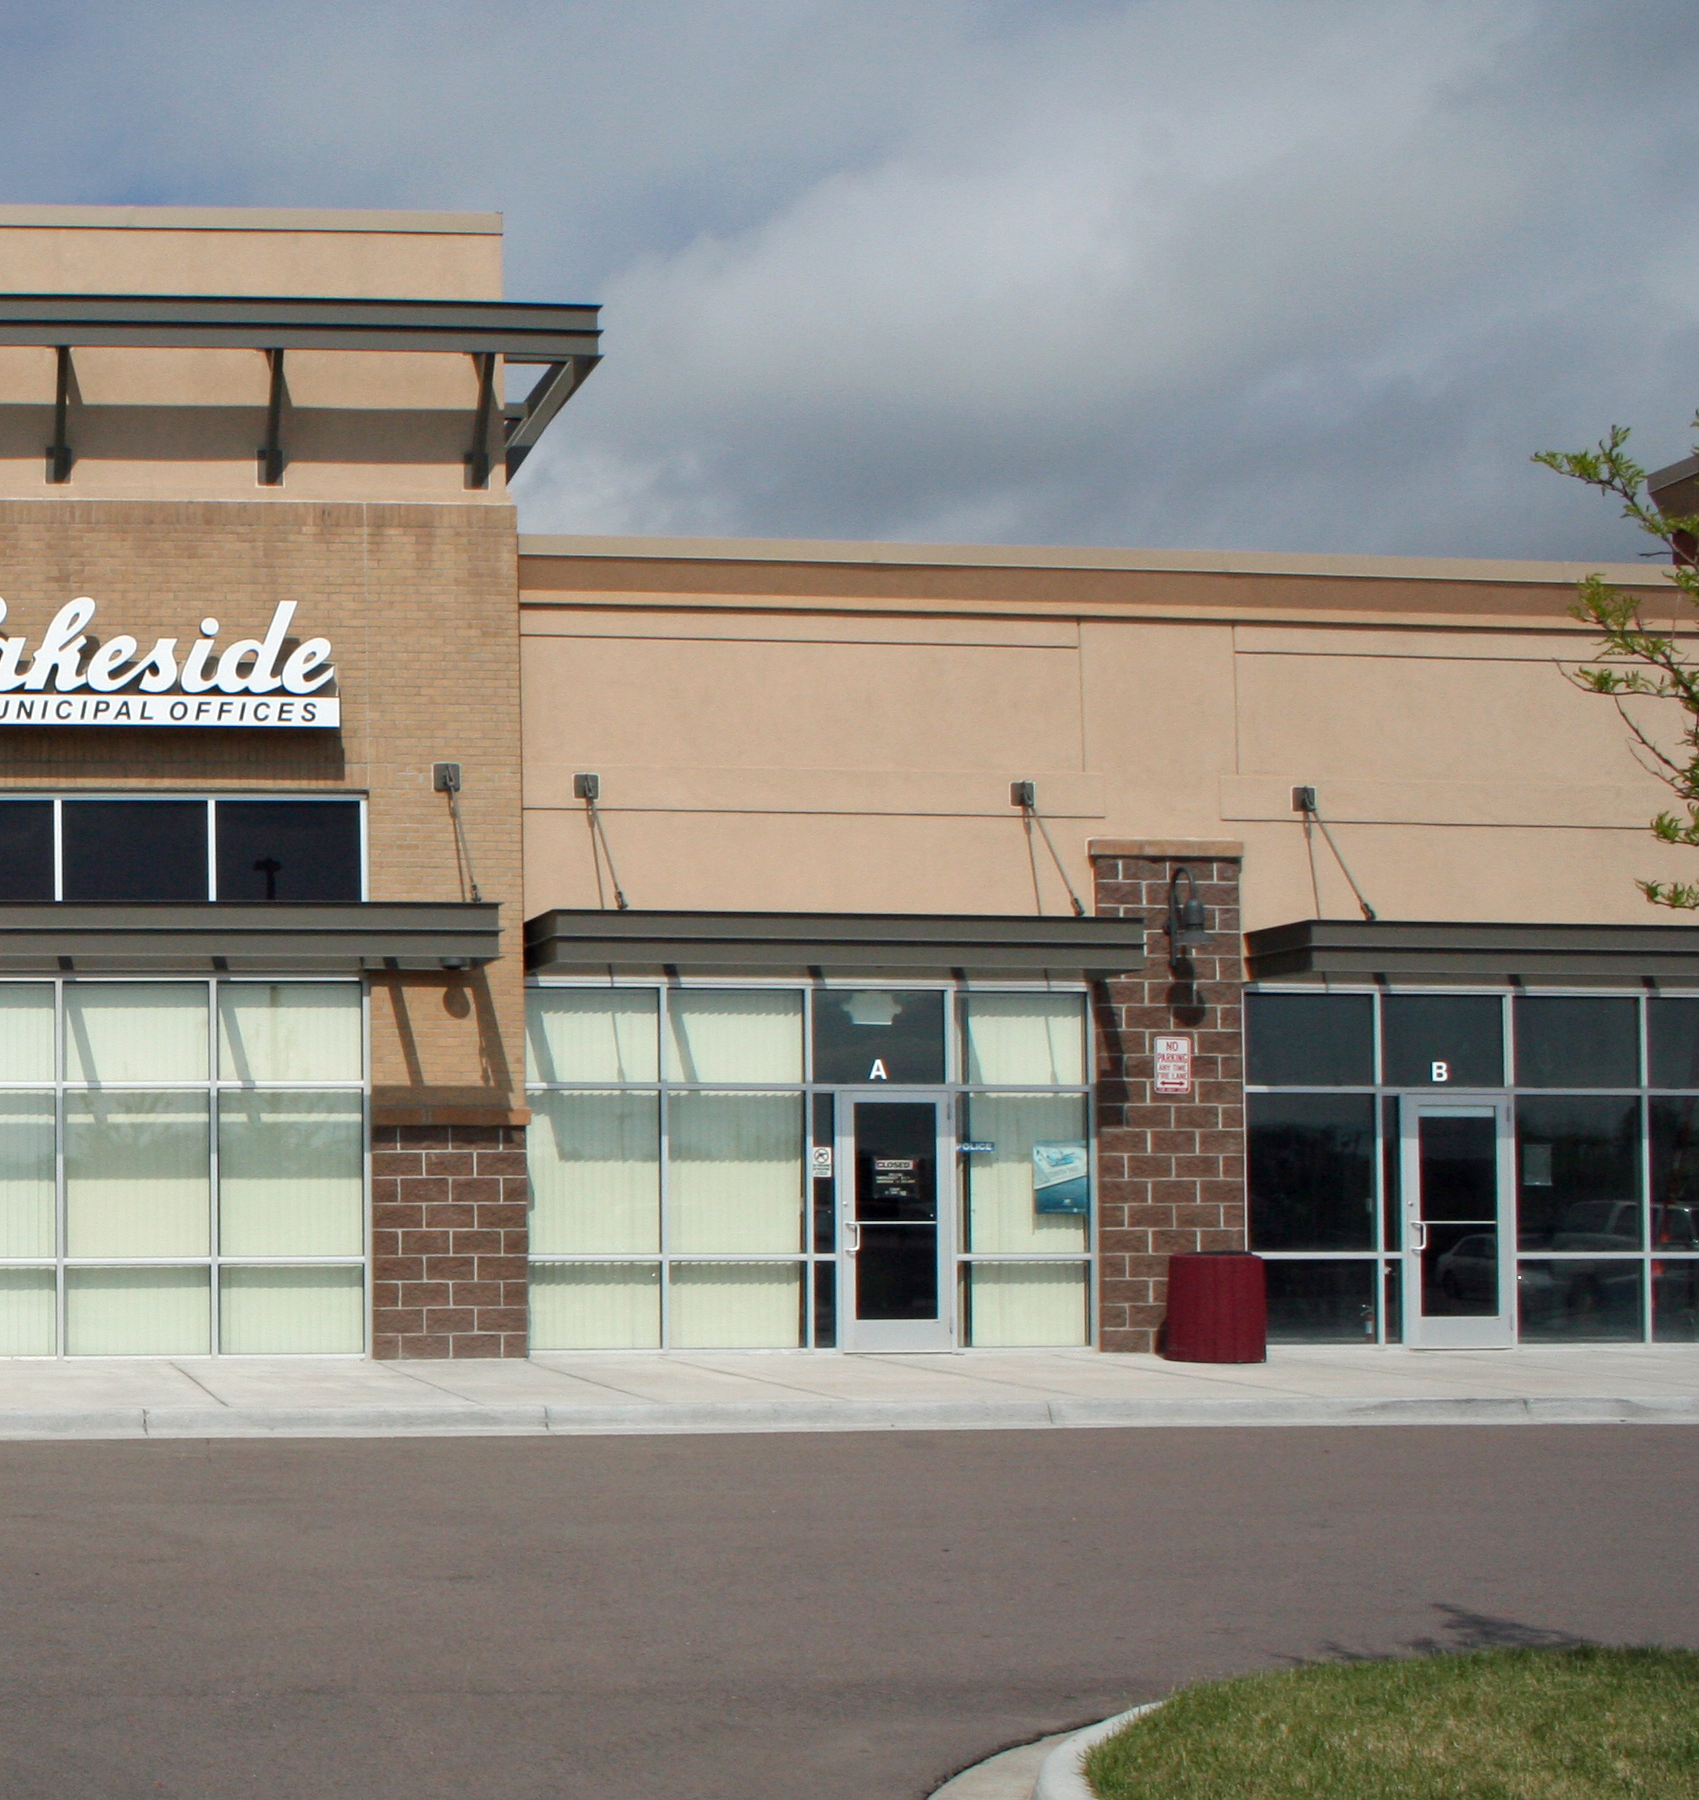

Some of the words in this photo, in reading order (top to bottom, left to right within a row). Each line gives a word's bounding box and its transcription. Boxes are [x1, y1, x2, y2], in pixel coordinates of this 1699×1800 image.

[168, 701, 321, 723] OFFICES
[1166, 1041, 1179, 1051] NO
[1157, 1052, 1189, 1062] PARKING
[868, 1058, 889, 1080] A
[1431, 1061, 1449, 1082] B
[876, 1161, 911, 1169] CLOSED
